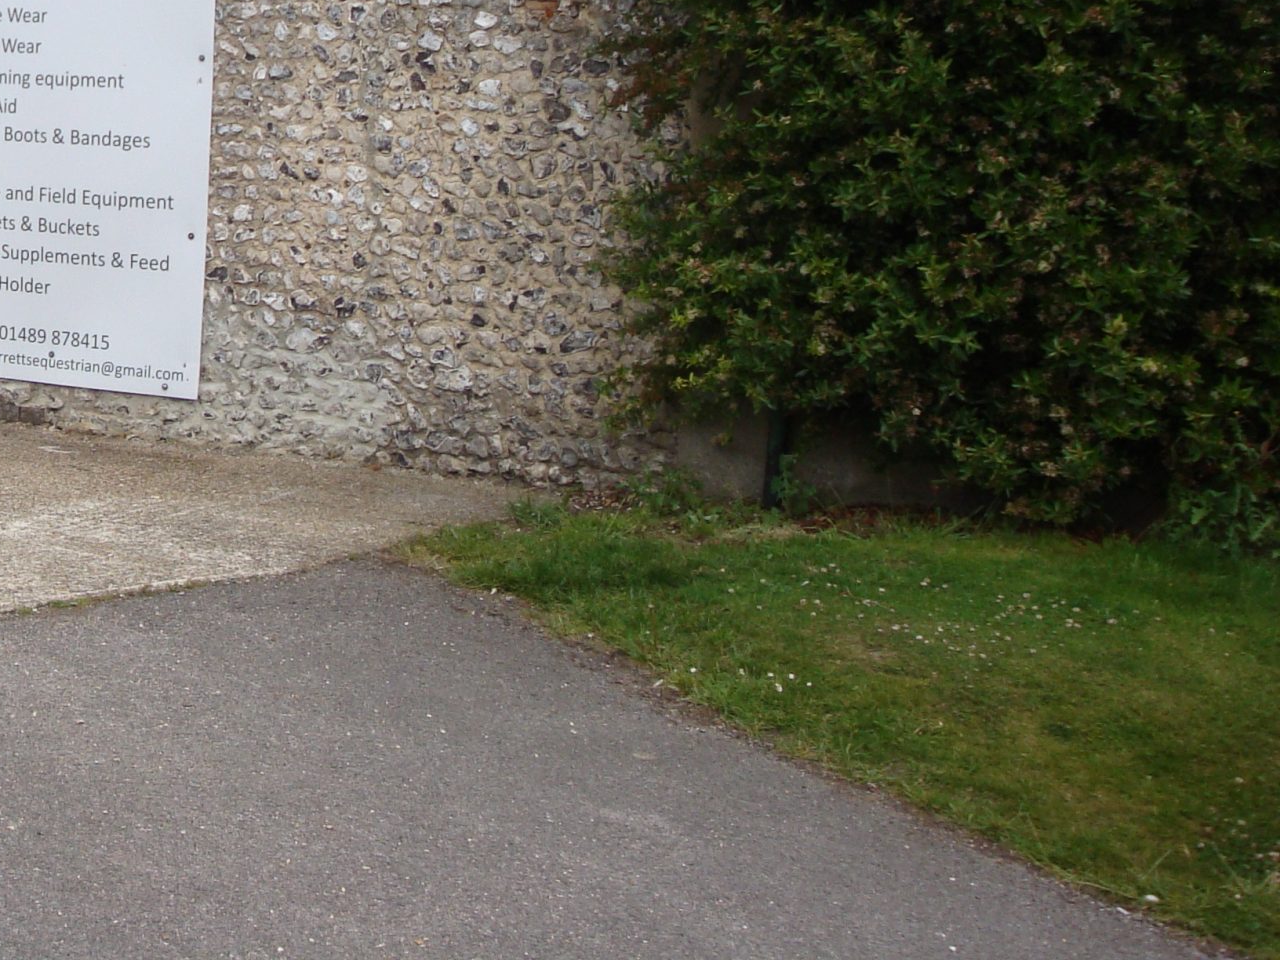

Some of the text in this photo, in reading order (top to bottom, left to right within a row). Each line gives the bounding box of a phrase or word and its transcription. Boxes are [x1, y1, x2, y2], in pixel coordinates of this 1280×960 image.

[7, 7, 48, 23] Wear
[1, 38, 42, 54] Wear
[35, 71, 125, 91] equipment
[4, 127, 47, 144] Boots
[52, 128, 65, 144] &
[71, 130, 151, 151] Bandages
[5, 186, 34, 202] and
[39, 187, 76, 205] Field
[82, 190, 174, 211] Equipment
[20, 216, 33, 232] &
[38, 217, 100, 237] Buckets
[1, 244, 106, 267] Supplements
[111, 252, 124, 268] &
[130, 254, 170, 272] Feed
[0, 276, 51, 294] Holder
[51, 330, 110, 350] 878415
